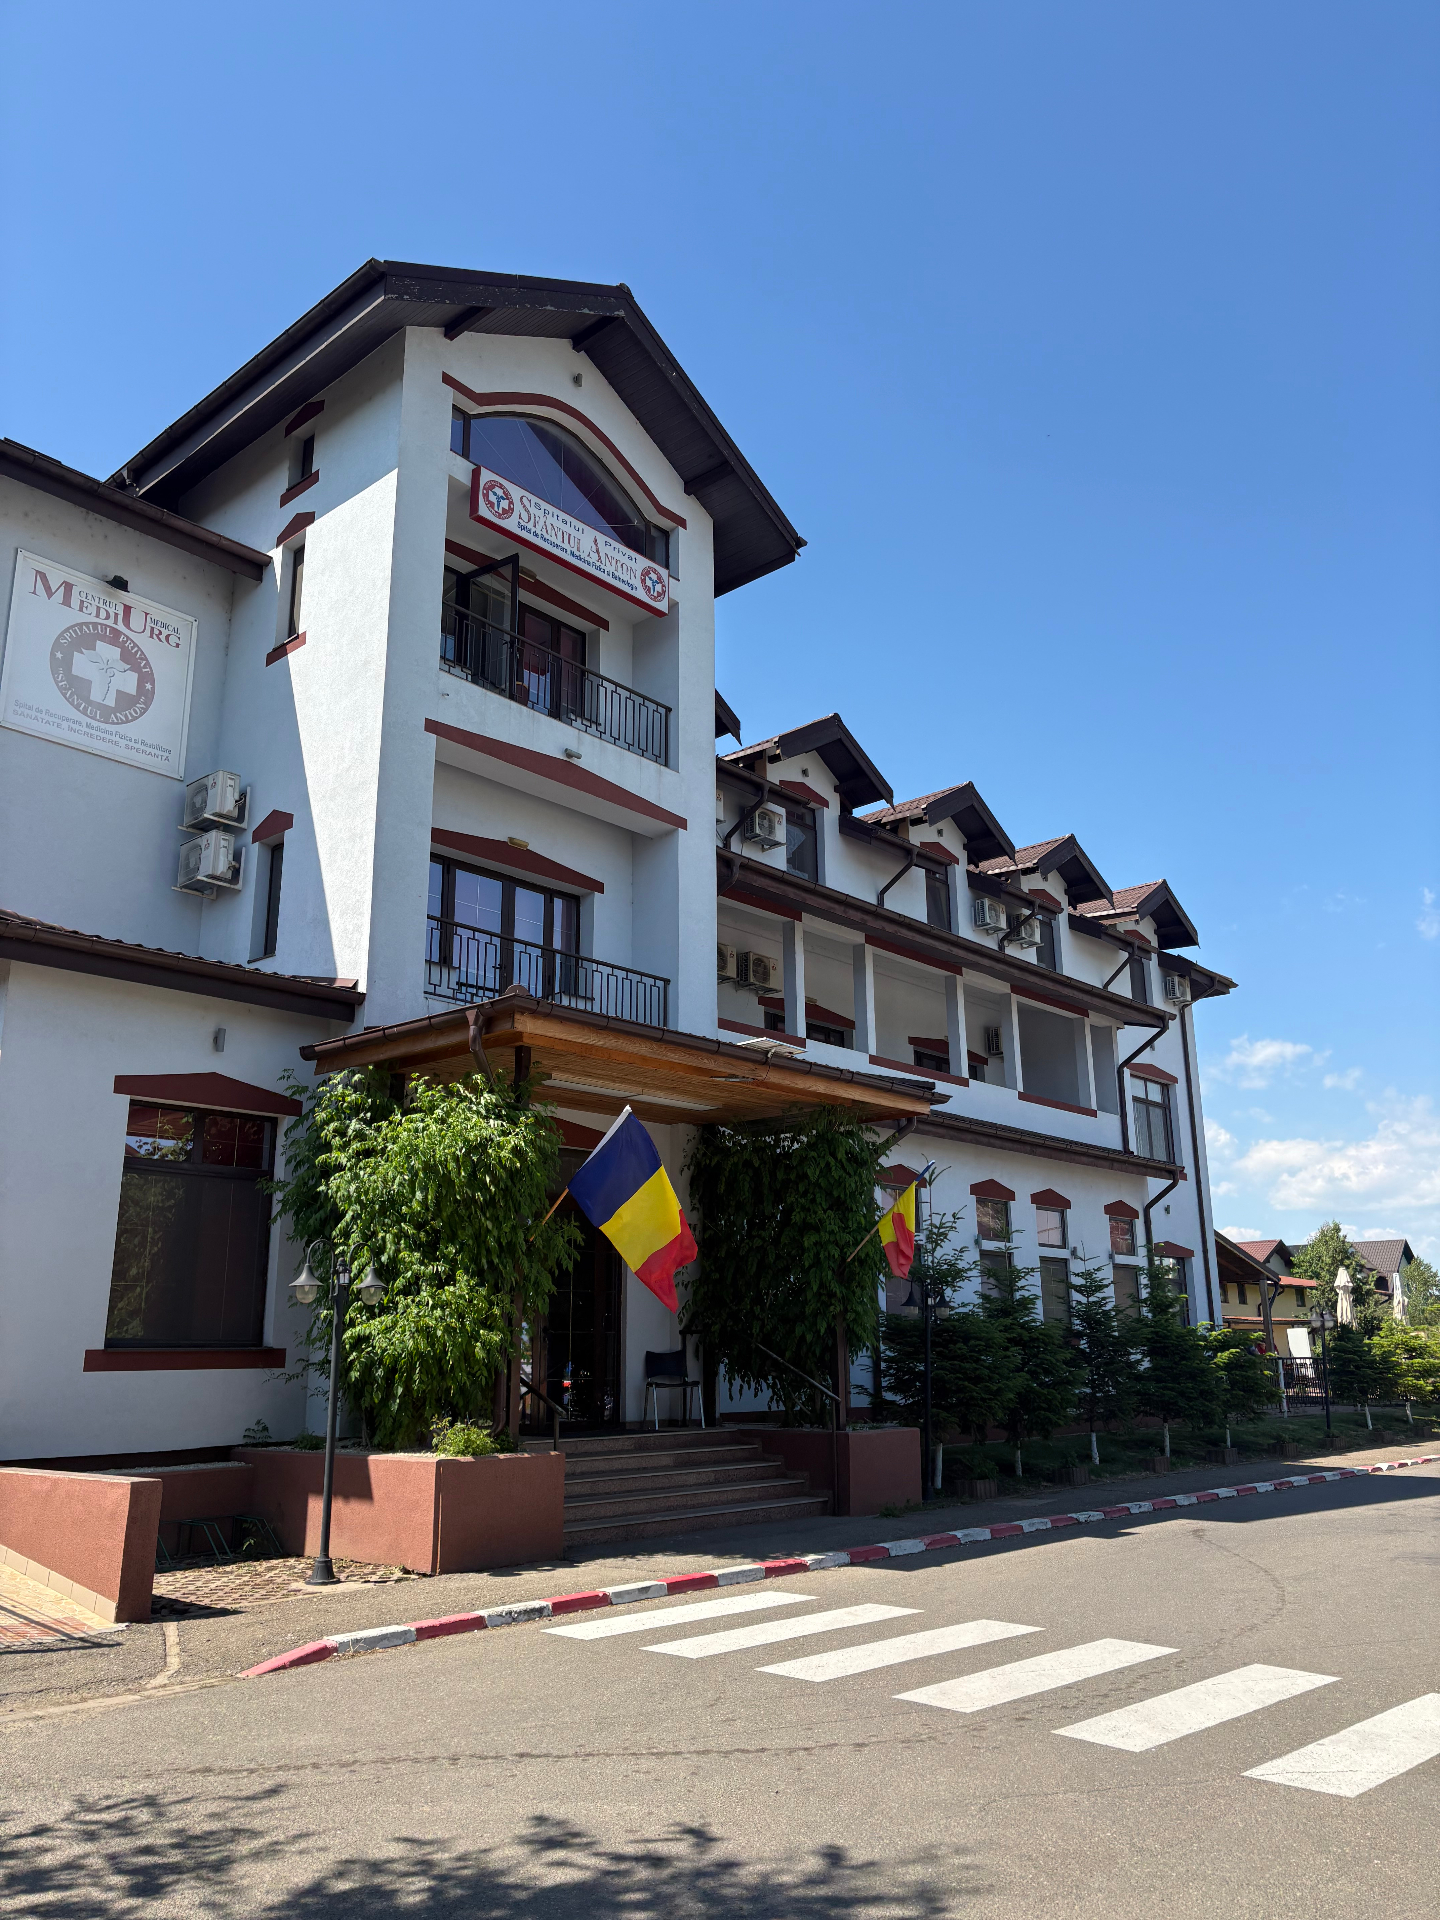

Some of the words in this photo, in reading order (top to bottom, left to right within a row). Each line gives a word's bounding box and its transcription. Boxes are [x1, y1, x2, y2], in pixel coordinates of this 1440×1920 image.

[534, 502, 585, 535] Spitalul
[604, 541, 638, 564] Privat
[78, 590, 119, 612] CENTRUL
[149, 616, 181, 636] MEDICAL
[60, 624, 113, 646] SPITALUL
[119, 634, 151, 674] PRIVAT
[14, 700, 34, 712] Spital
[35, 706, 43, 714] de
[44, 708, 84, 728] Recuperare,
[85, 721, 114, 737] Medicina
[114, 730, 133, 743] Fizica
